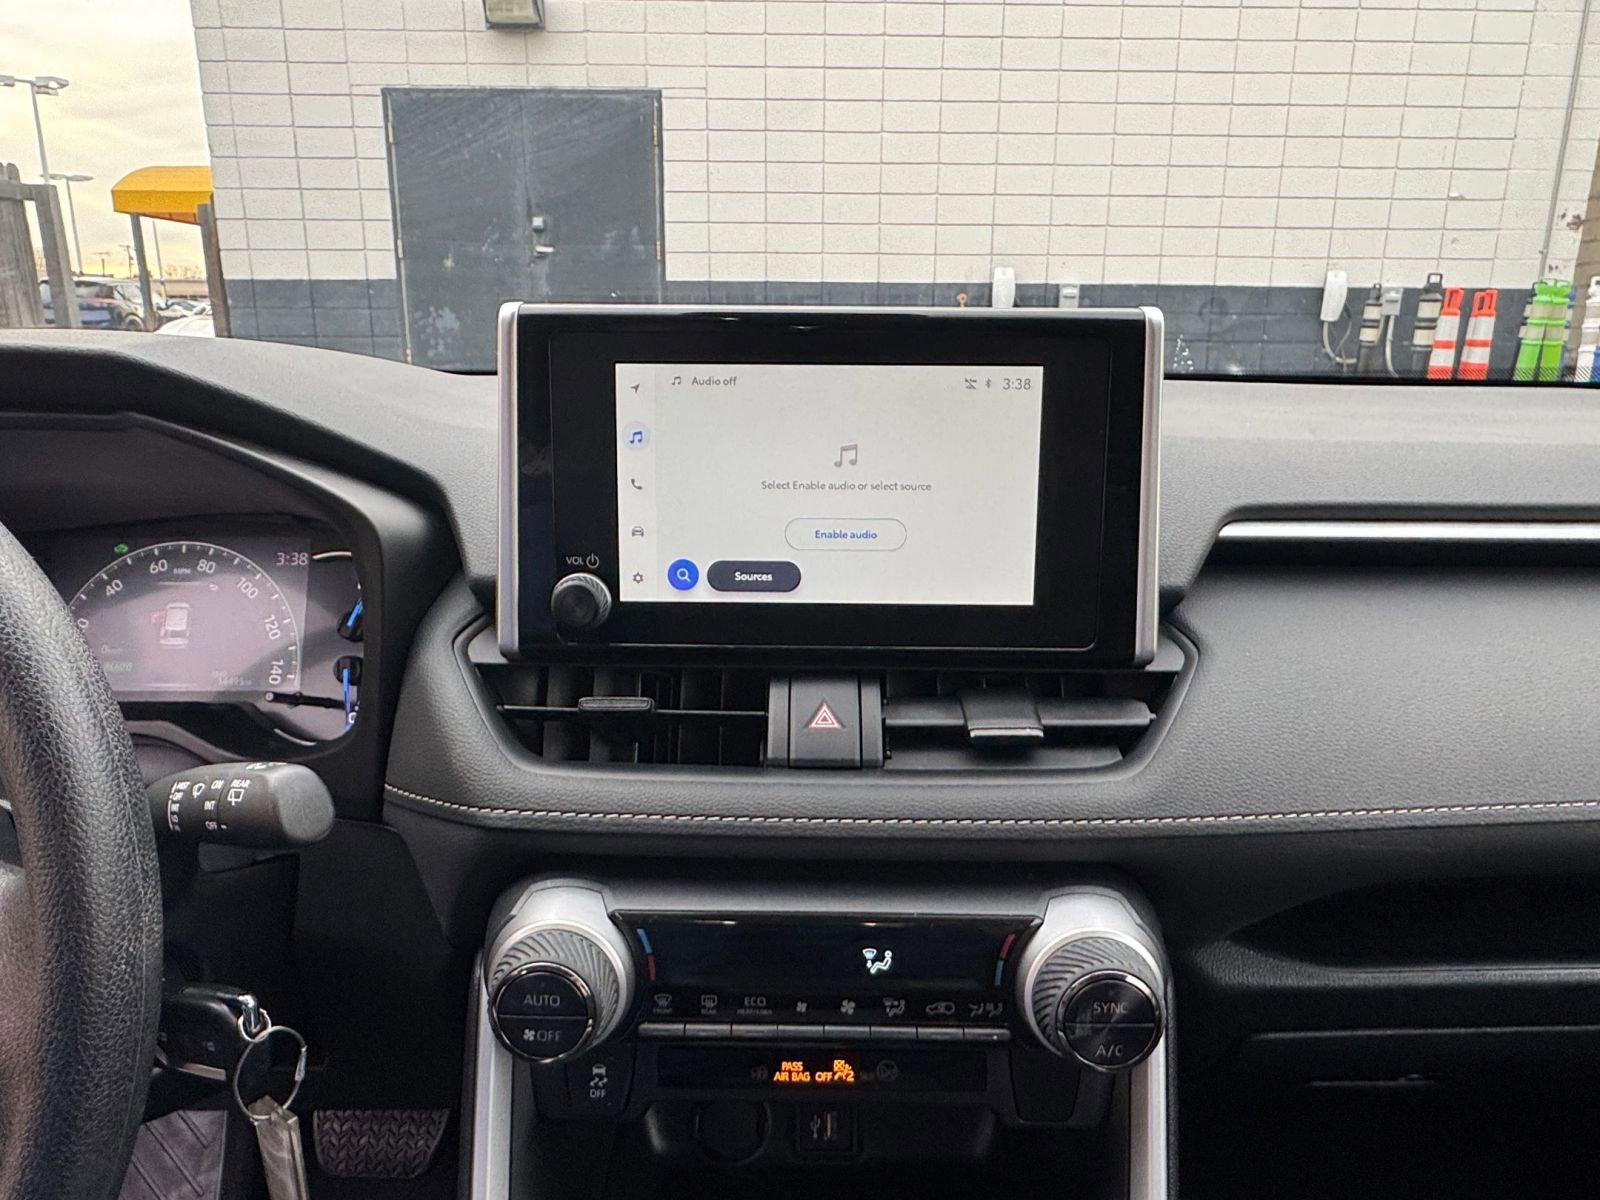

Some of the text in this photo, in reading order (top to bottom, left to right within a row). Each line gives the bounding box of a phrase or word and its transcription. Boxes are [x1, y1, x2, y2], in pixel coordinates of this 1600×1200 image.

[691, 376, 737, 386] Audio off
[1002, 378, 1031, 390] 3:38
[761, 480, 932, 492] Select Enable audio or select source
[815, 530, 878, 540] Enable audio
[276, 552, 308, 566] 3:38
[566, 556, 585, 565] VOL
[149, 559, 168, 574] 60
[173, 567, 191, 575] MPH
[197, 559, 216, 574] 80
[734, 571, 773, 582] Sources
[105, 579, 123, 596] 40
[236, 577, 259, 599] 100
[264, 614, 281, 640] 120
[268, 659, 284, 685] 140
[230, 779, 251, 788] REAR
[204, 800, 216, 811] INT
[524, 994, 560, 1007] AUTO
[744, 996, 767, 1007] ECO
[1093, 1002, 1128, 1014] SYNC
[536, 1030, 560, 1041] OFF
[1095, 1045, 1123, 1057] A/C
[781, 1061, 803, 1071] PASS
[773, 1071, 833, 1081] AIR BAG OFF
[590, 1089, 605, 1098] OFF
